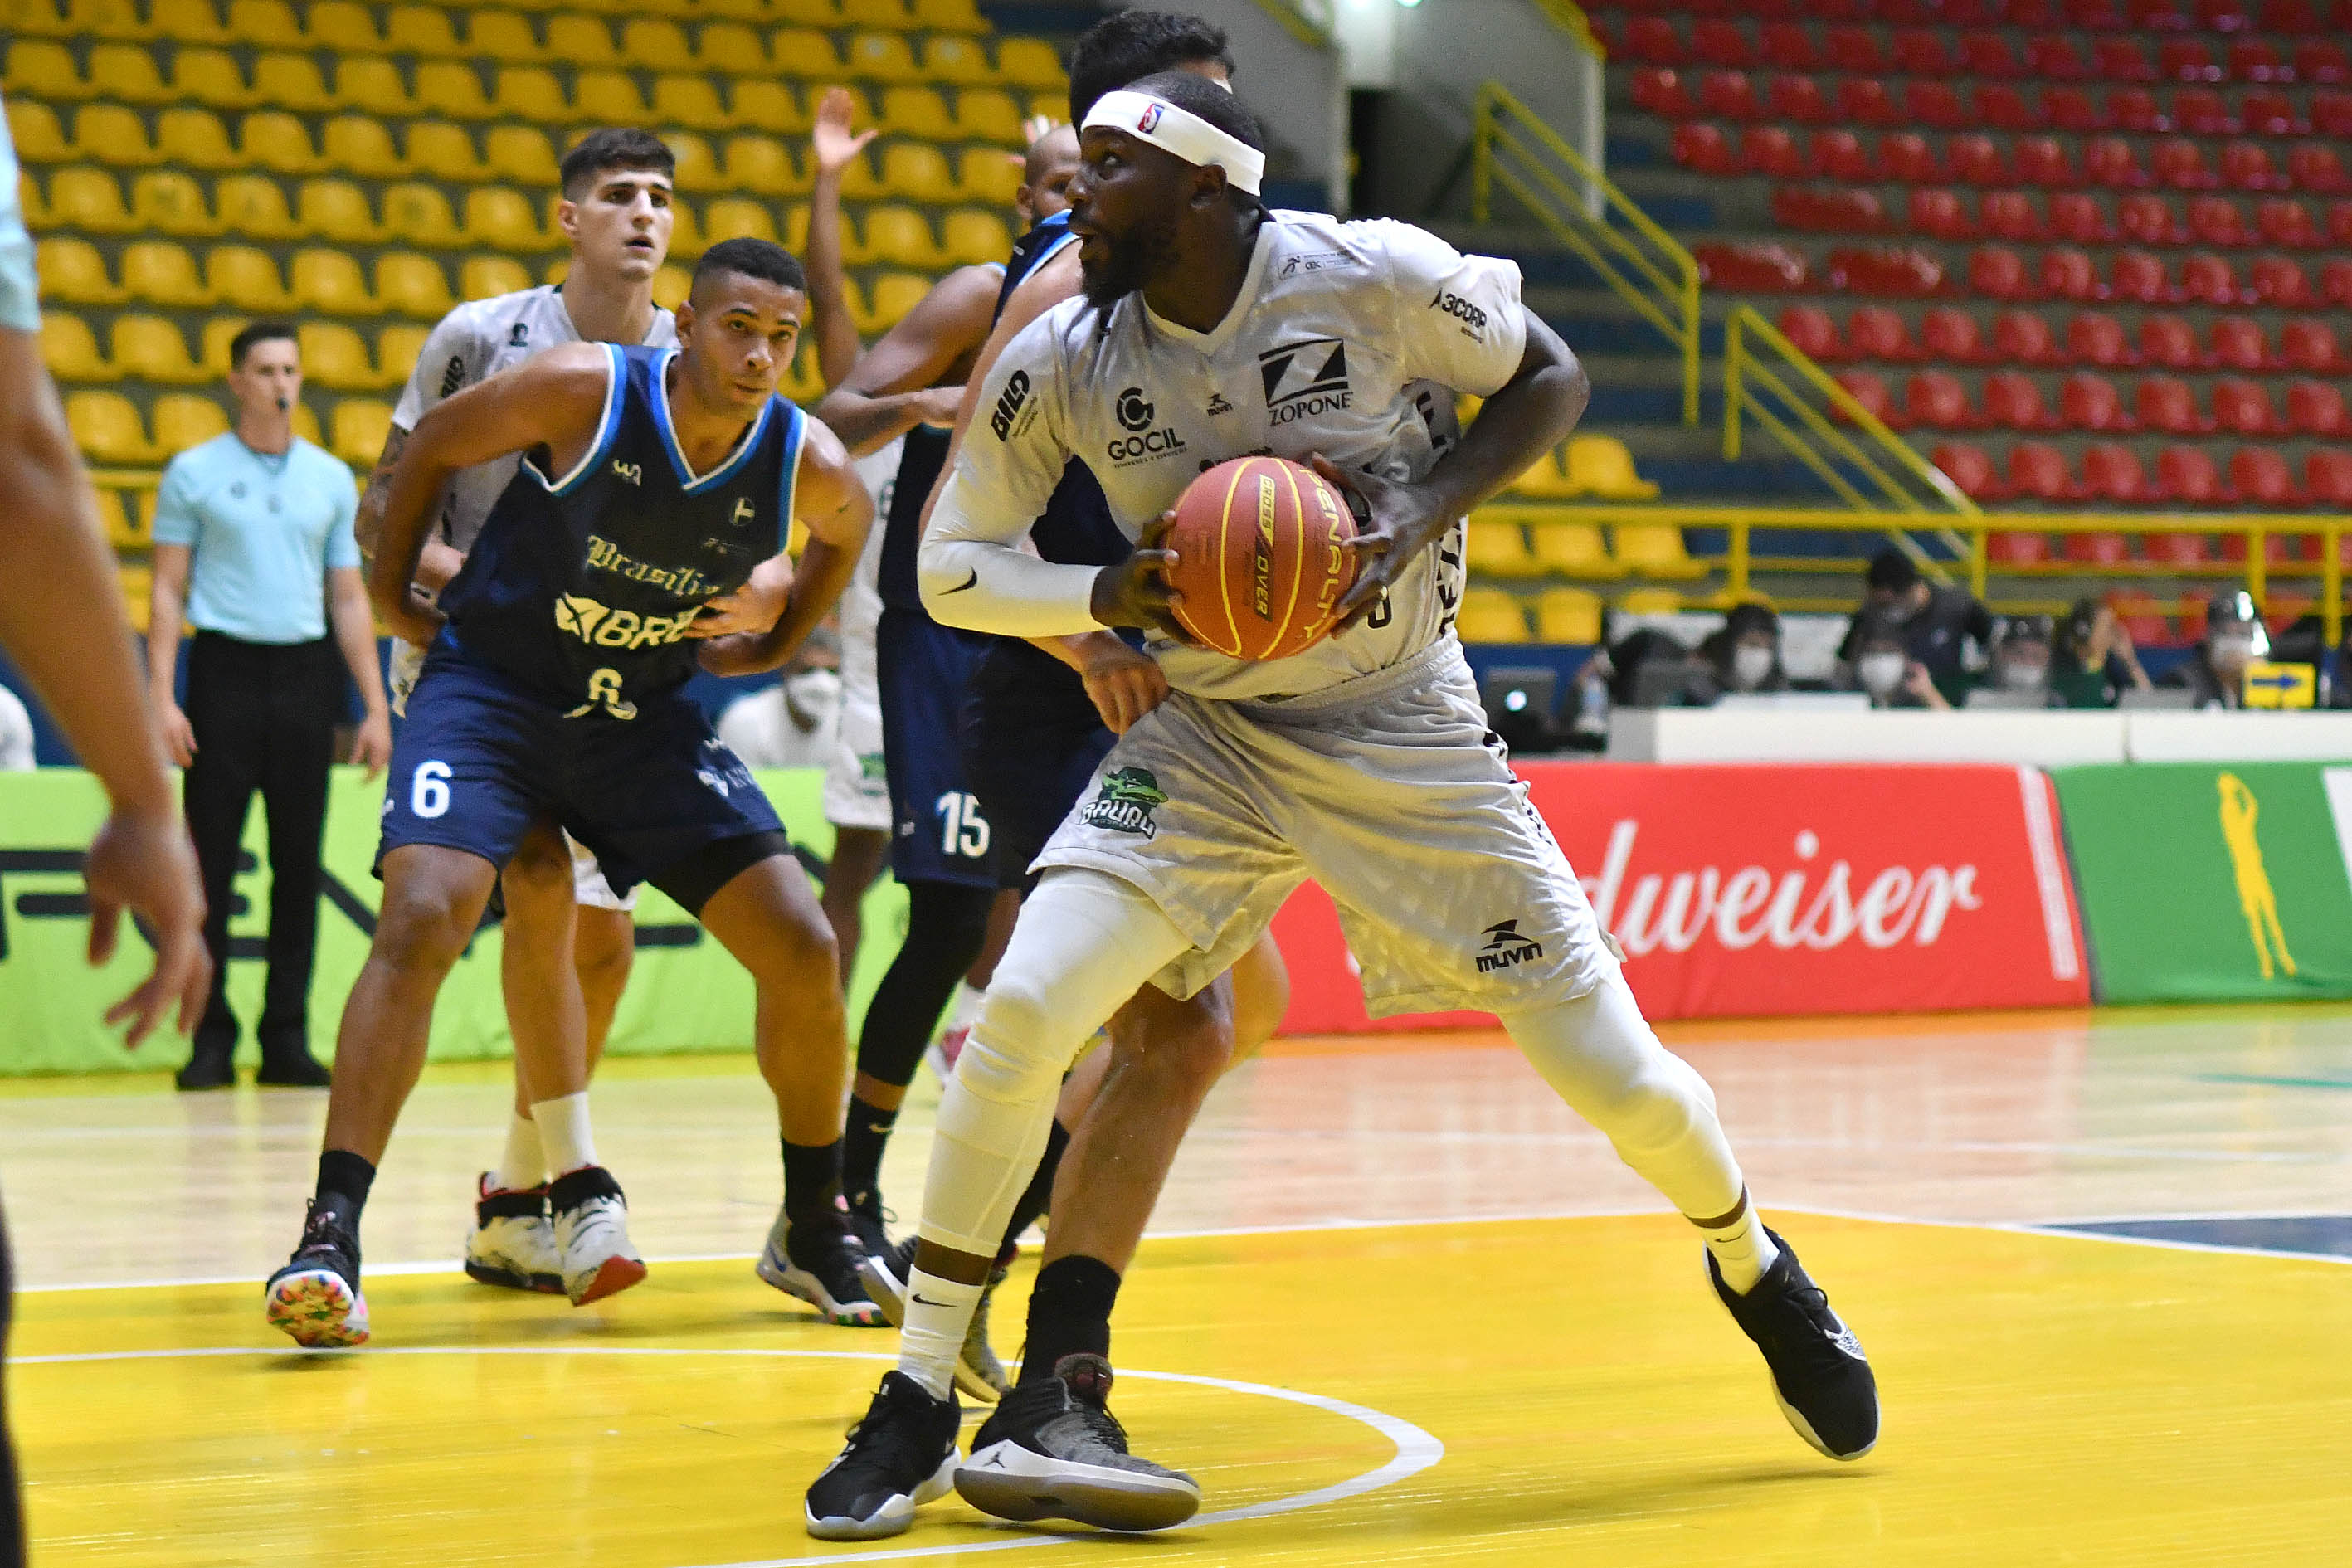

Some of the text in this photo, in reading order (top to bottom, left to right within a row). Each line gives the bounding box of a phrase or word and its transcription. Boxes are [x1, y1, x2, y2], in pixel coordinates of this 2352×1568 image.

[1427, 287, 1488, 329] A3CORP
[1269, 391, 1353, 427] ZOPONE
[1107, 427, 1186, 460] GOCIL
[1254, 554, 1269, 616] OVER
[411, 760, 454, 818] 6
[937, 791, 991, 858] 15
[1475, 942, 1543, 973] muvin
